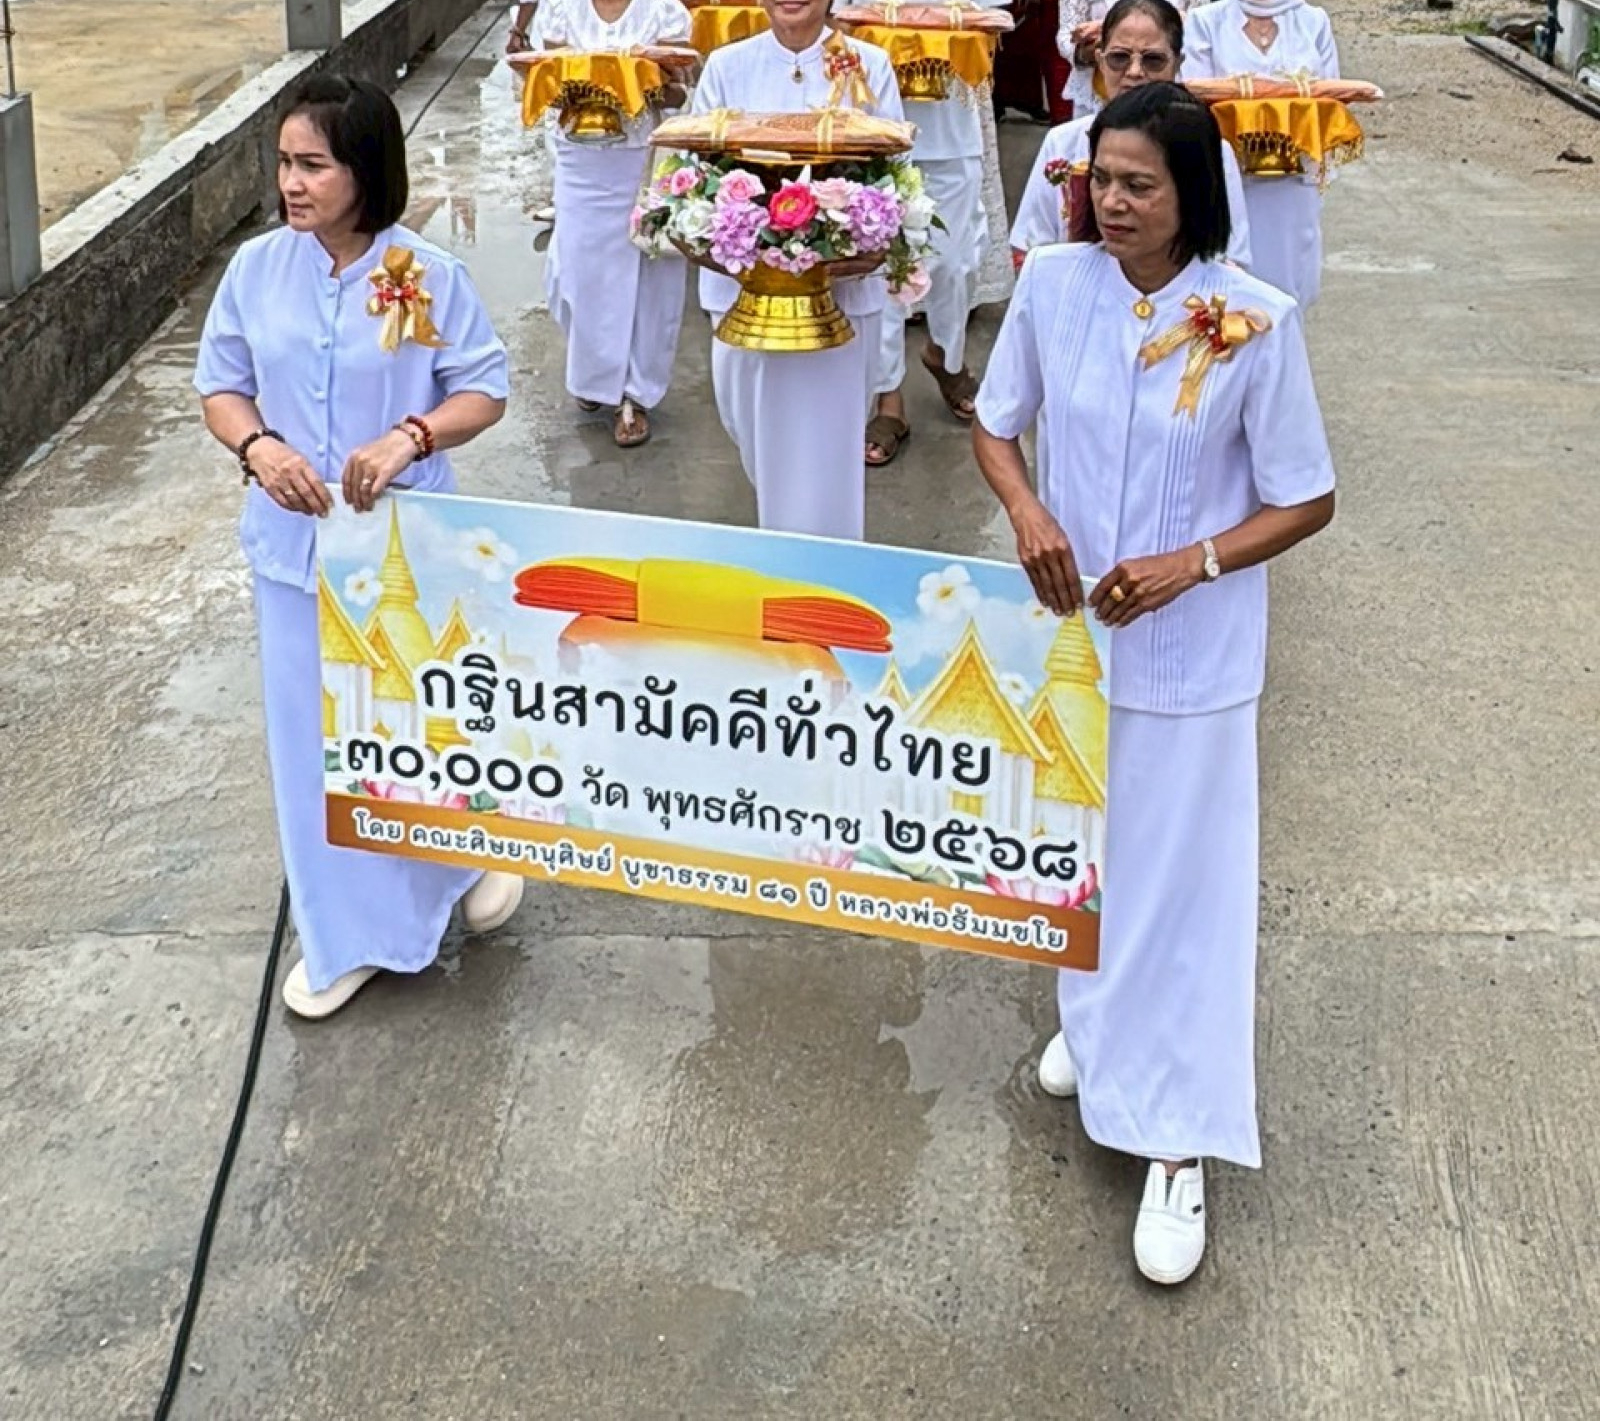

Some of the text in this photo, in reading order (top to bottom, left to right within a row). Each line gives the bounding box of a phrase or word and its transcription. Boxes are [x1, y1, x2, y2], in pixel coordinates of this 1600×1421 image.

[421, 652, 991, 787] กฐินสามัคคีทั่วไทย
[347, 737, 1078, 881] ๓๐,๐๐๐ วัด พุทธศักราช ๒๕๖๘
[355, 812, 1065, 949] โดย คณะศิษยานุศิษย์ บูชาธรรม ๘๑ ปี หลวงพ่อธัมมชโย
